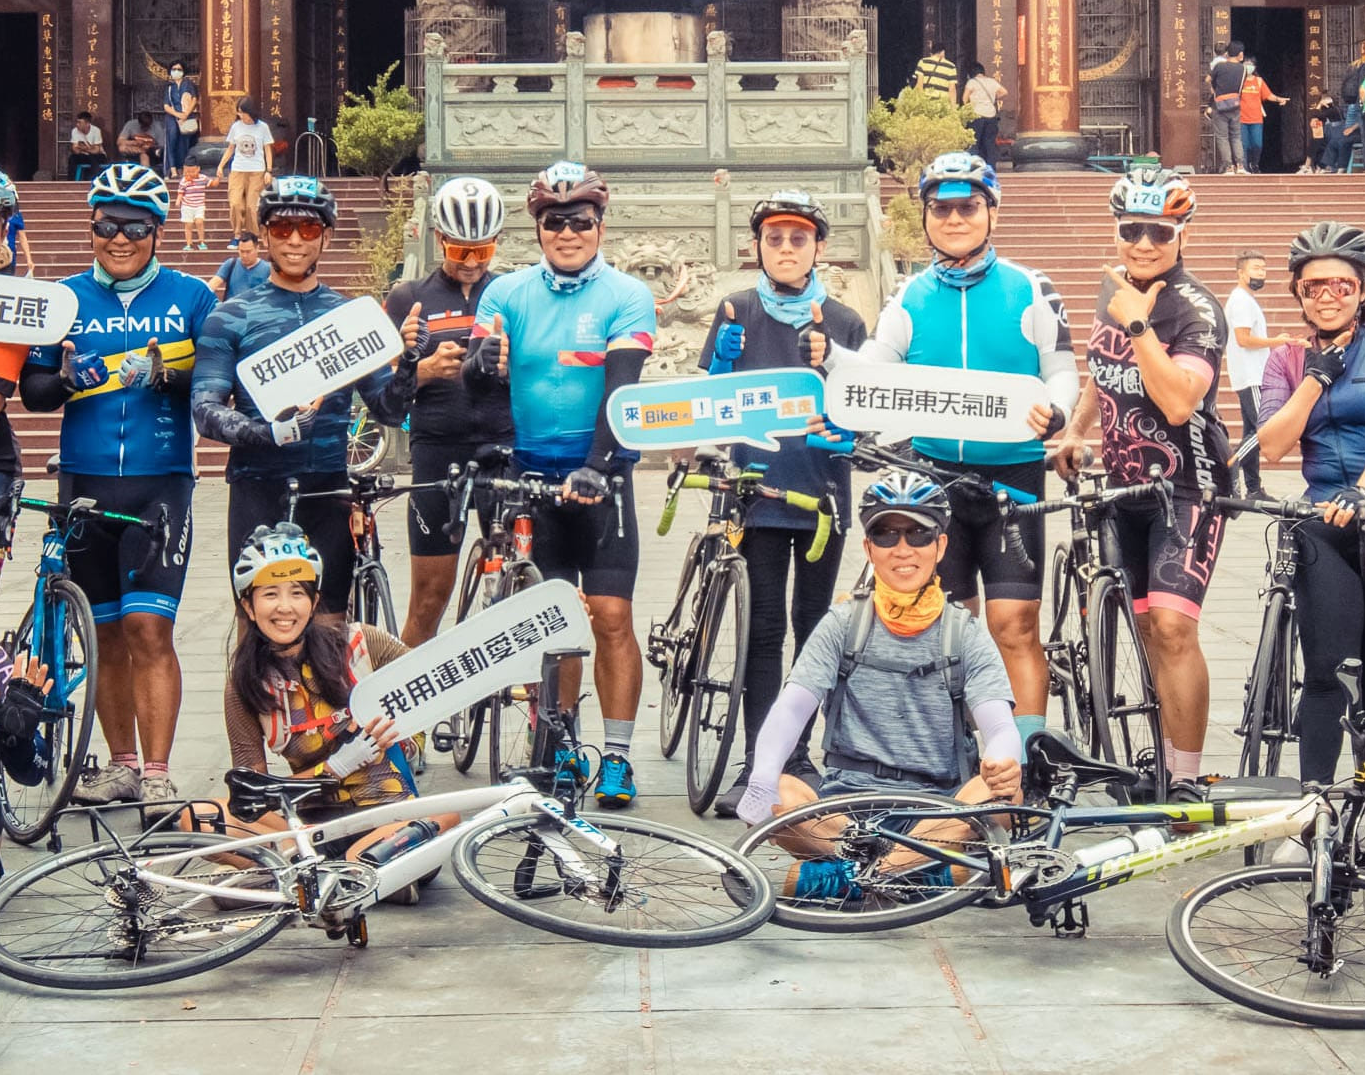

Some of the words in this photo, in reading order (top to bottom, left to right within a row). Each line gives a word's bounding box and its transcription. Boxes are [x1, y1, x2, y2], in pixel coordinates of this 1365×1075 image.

[68, 316, 185, 336] GARMIN
[251, 324, 344, 385] 好吃好玩
[645, 409, 679, 424] Bike
[844, 383, 1009, 419] 我在屏東天氣晴
[378, 604, 569, 720] 我用運動愛臺灣
